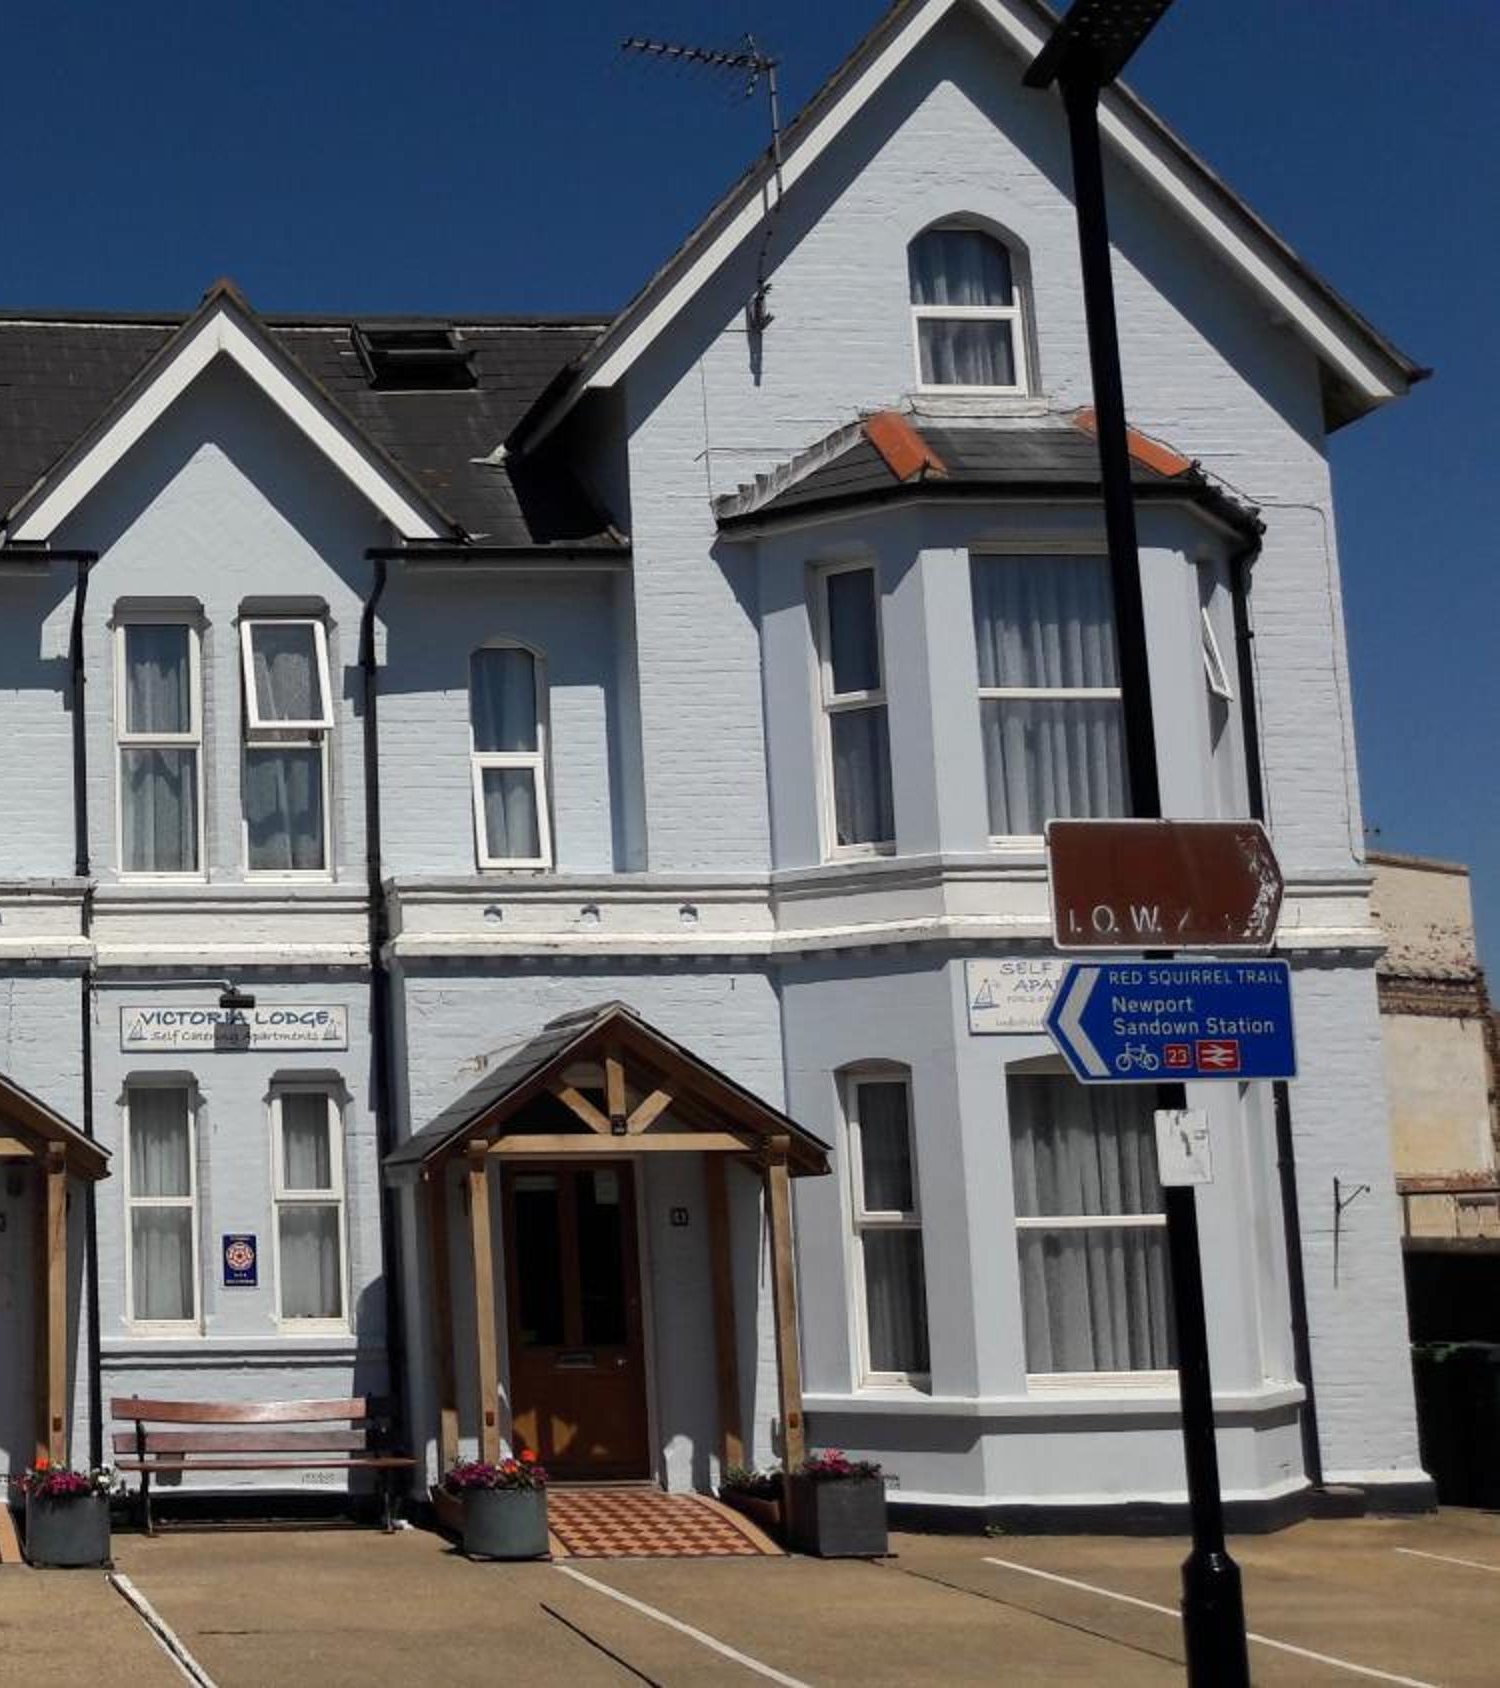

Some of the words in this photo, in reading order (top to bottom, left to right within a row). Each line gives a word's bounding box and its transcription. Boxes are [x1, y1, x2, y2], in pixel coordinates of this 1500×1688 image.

[999, 961, 1053, 976] SELF
[1109, 971, 1142, 985] RED
[1149, 970, 1233, 985] SQUIRREL
[1237, 969, 1283, 985] TRAIL
[1112, 996, 1194, 1015] Newport
[140, 1010, 247, 1025] VICTORIA
[255, 1010, 329, 1028] LODGE
[1113, 1018, 1199, 1036] Sandown
[1206, 1017, 1275, 1035] Station
[150, 1029, 180, 1045] Self
[1168, 1049, 1188, 1064] 23
